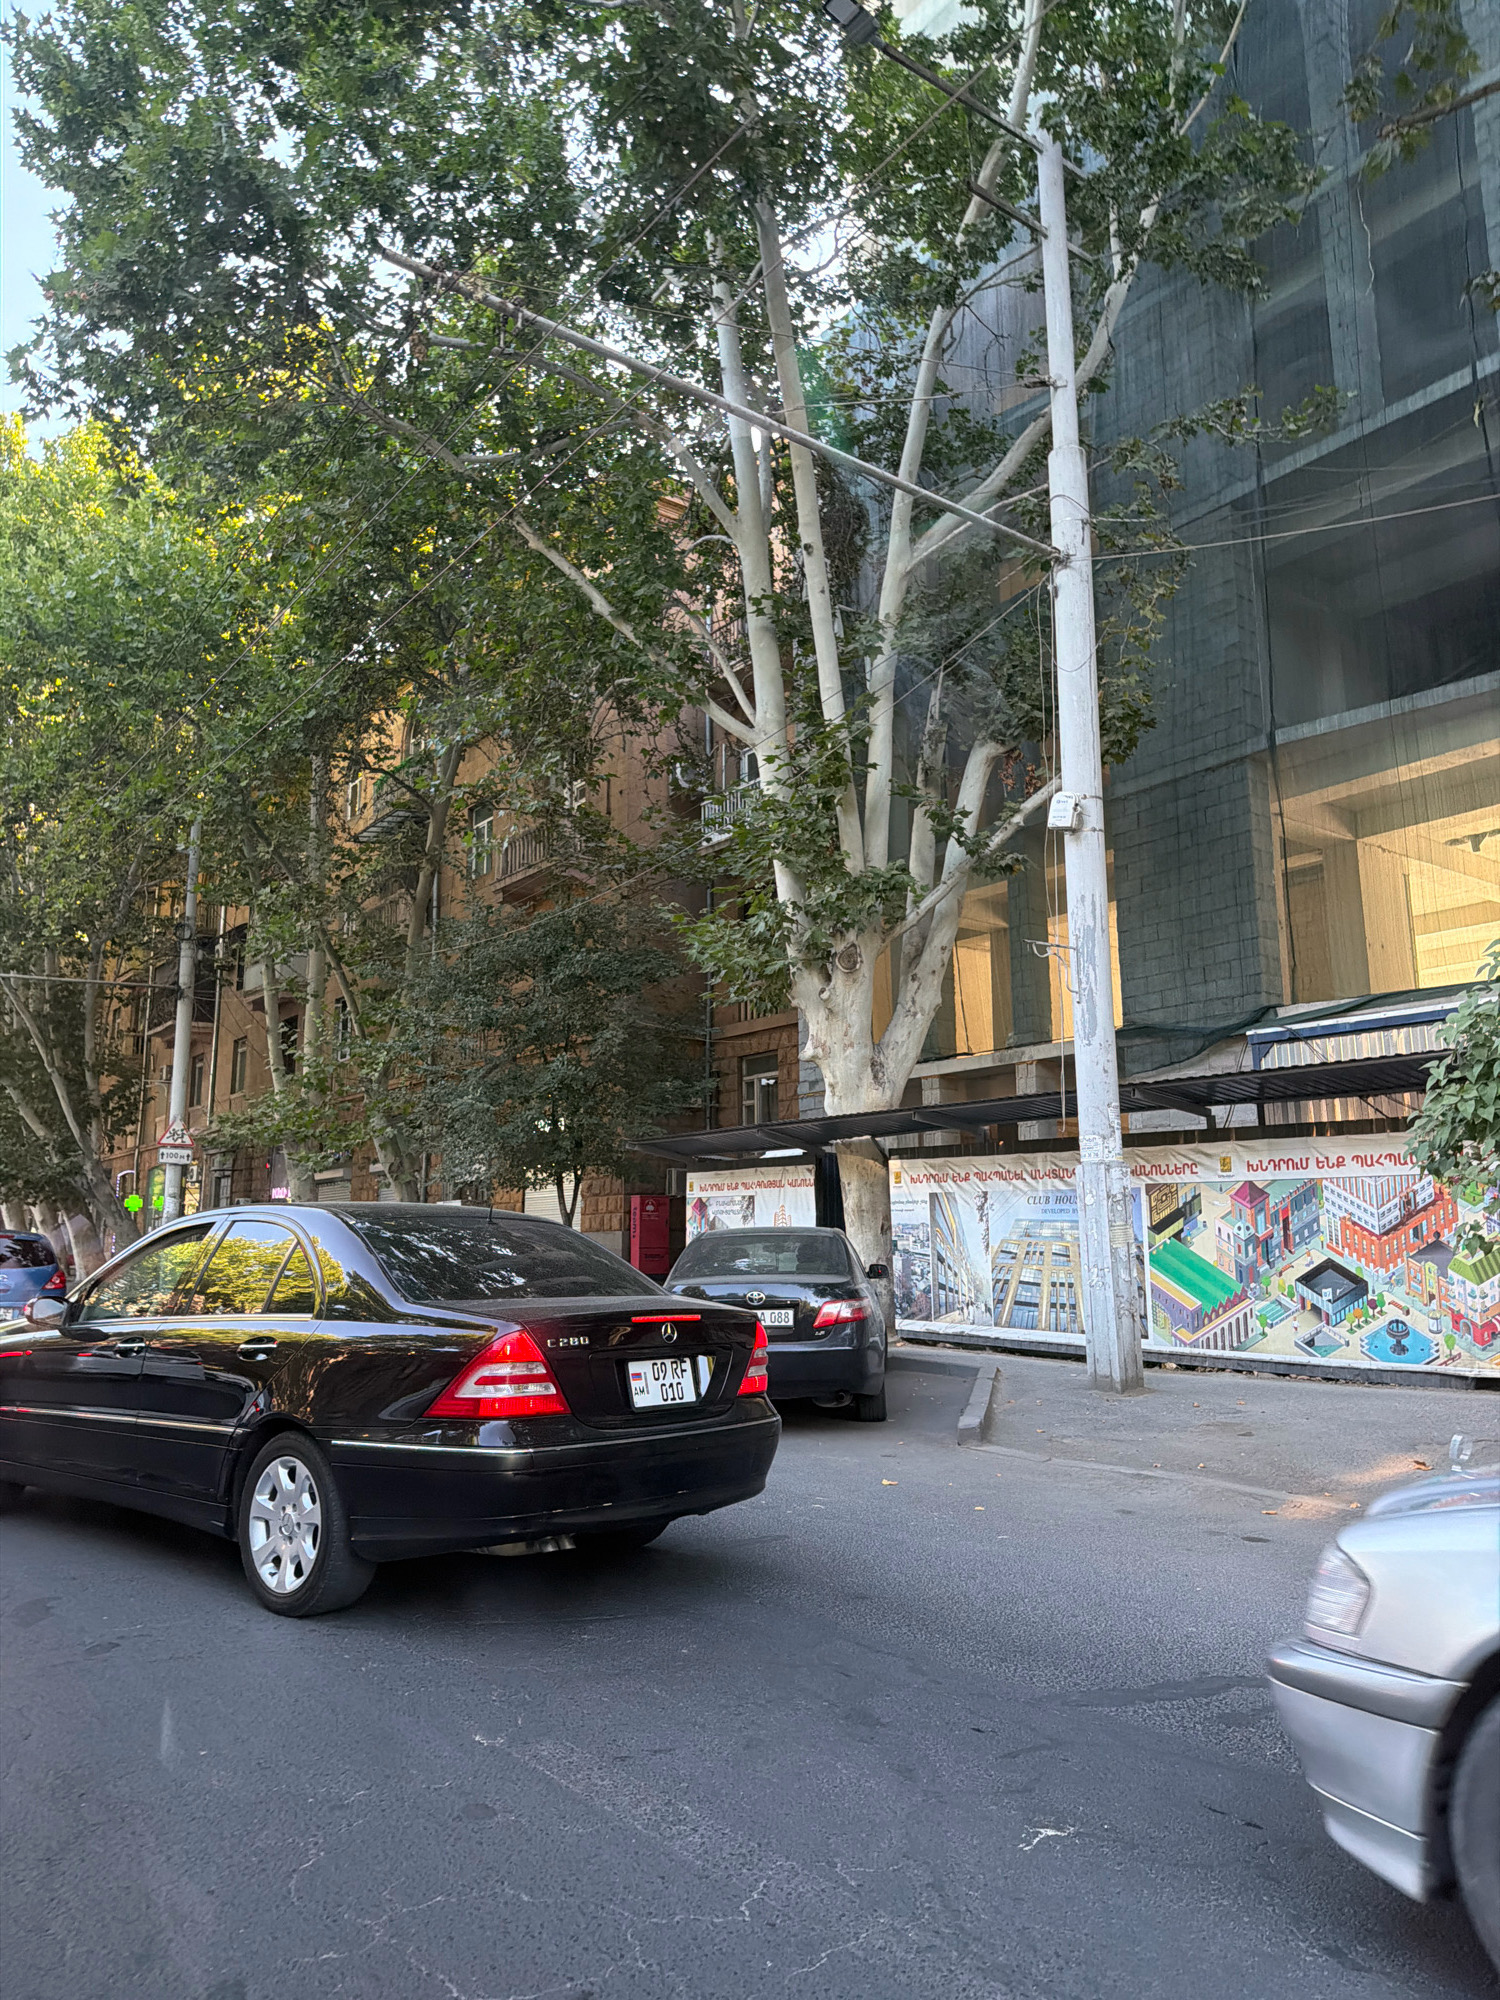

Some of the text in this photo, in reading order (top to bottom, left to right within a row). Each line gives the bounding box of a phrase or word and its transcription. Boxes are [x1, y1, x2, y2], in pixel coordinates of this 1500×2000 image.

[1315, 1155, 1346, 1169] ԵՆՔ
[787, 1178, 815, 1188] ԿԱՆՈՆՆ
[1027, 1195, 1051, 1205] CLUB
[770, 1311, 790, 1323] 088
[547, 1336, 589, 1348] C 280
[652, 1359, 687, 1381] 09 RF
[634, 1386, 646, 1396] AM
[660, 1382, 684, 1402] 010
